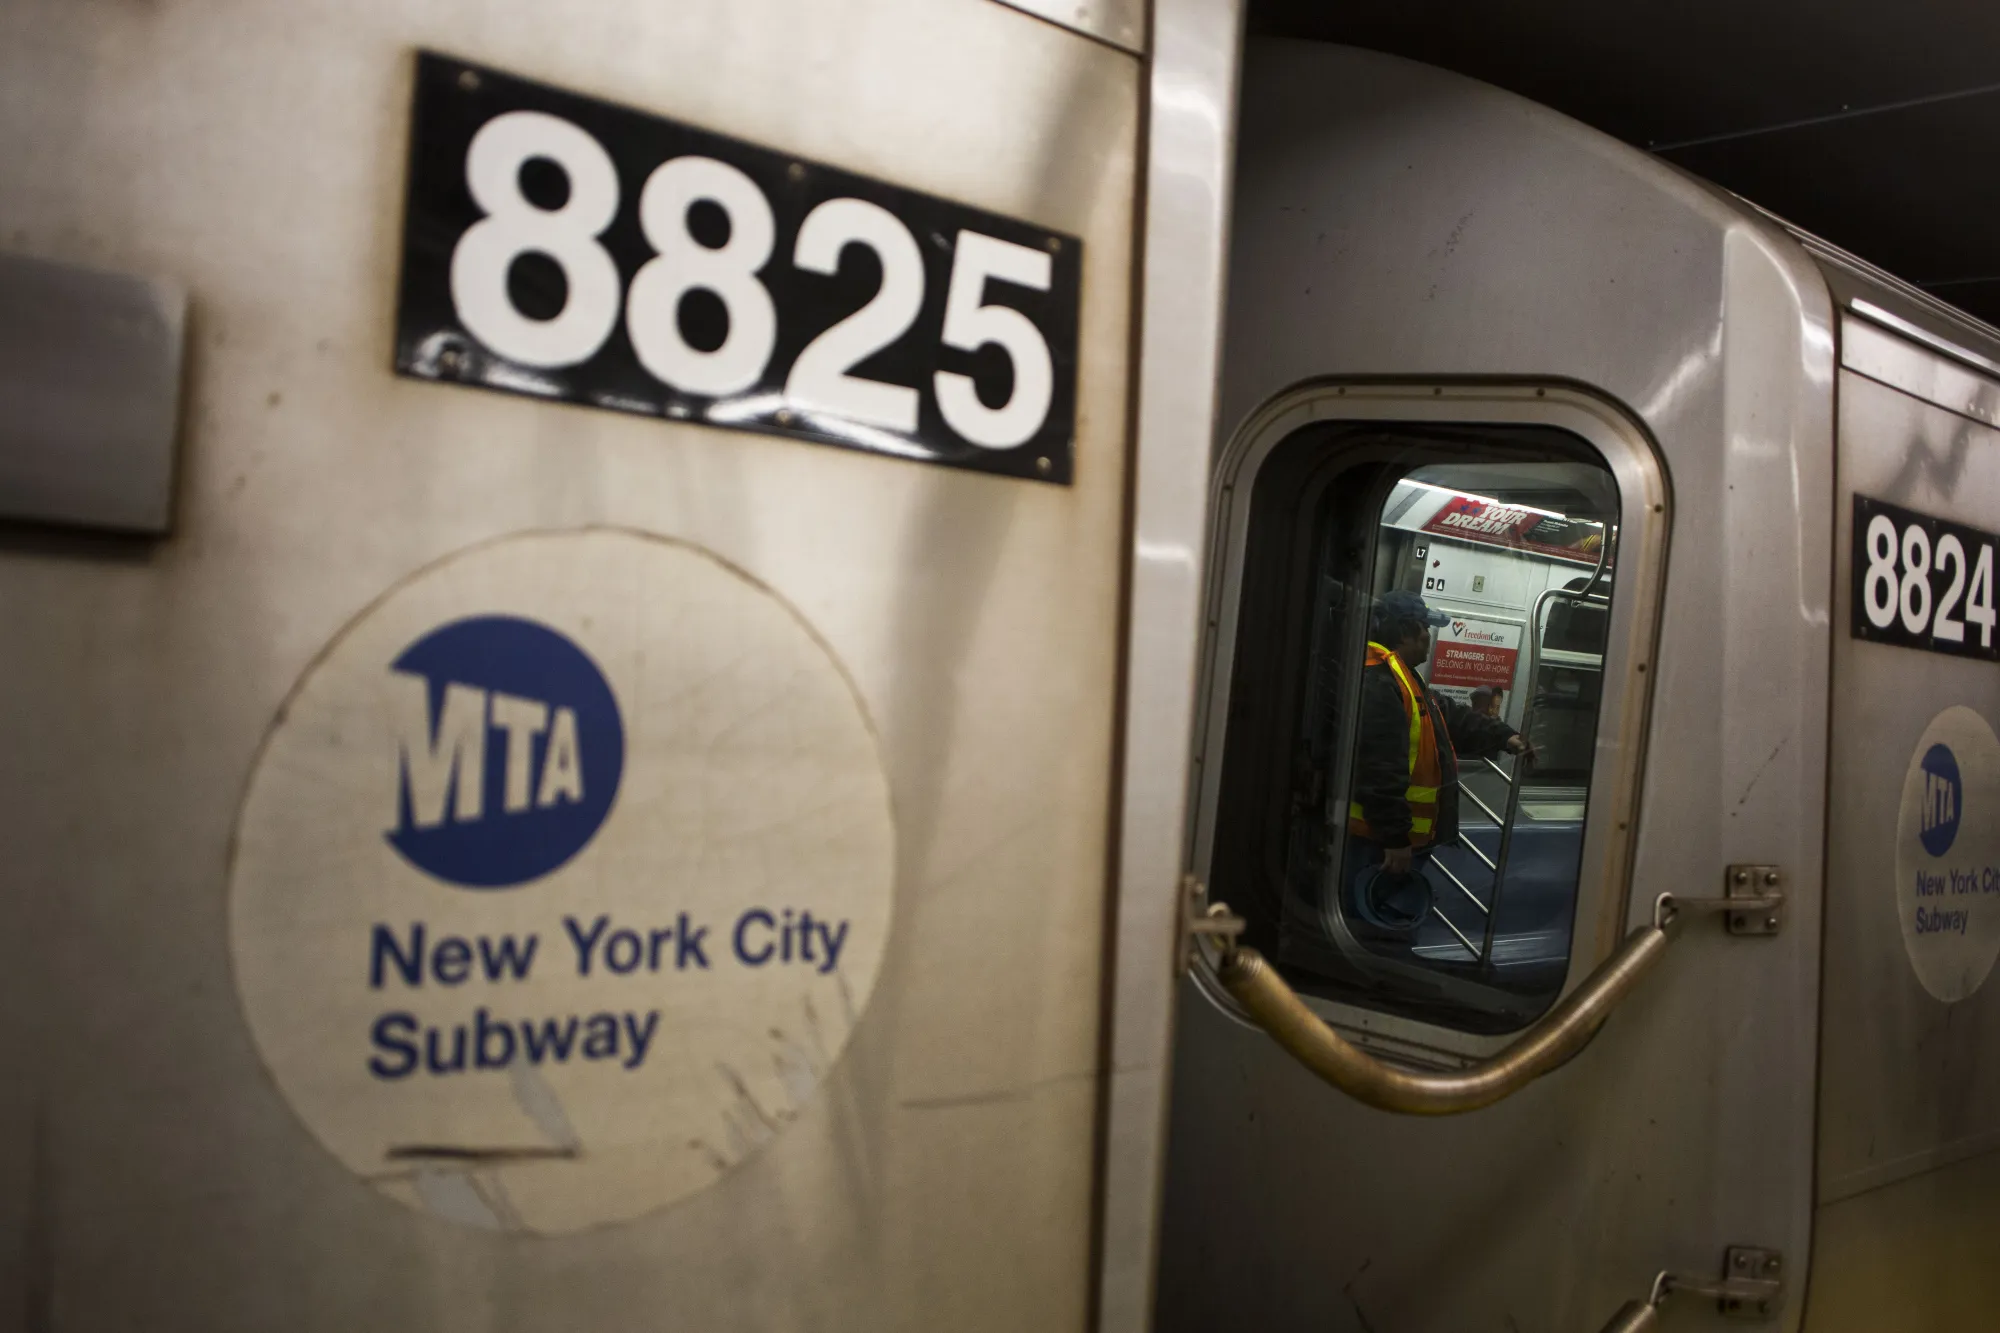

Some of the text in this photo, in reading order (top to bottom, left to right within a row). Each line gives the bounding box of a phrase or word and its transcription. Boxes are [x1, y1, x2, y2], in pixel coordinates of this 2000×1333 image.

[451, 110, 1054, 450] 8825
[1441, 512, 1511, 535] DREAM
[1480, 506, 1527, 525] YOUR
[1416, 548, 1426, 558] L7
[1864, 514, 1997, 648] 8824
[1464, 628, 1505, 642] FreedomCare
[1436, 658, 1511, 674] BELONG IN YOUR HOME
[1446, 649, 1506, 663] STRANGERS DON'T
[392, 671, 585, 829] MTA
[1921, 767, 1955, 832] MTA
[1916, 866, 2000, 897] New York Cit
[1916, 907, 1969, 935] Subway
[368, 906, 850, 990] New York City
[367, 1006, 661, 1080] Subway
